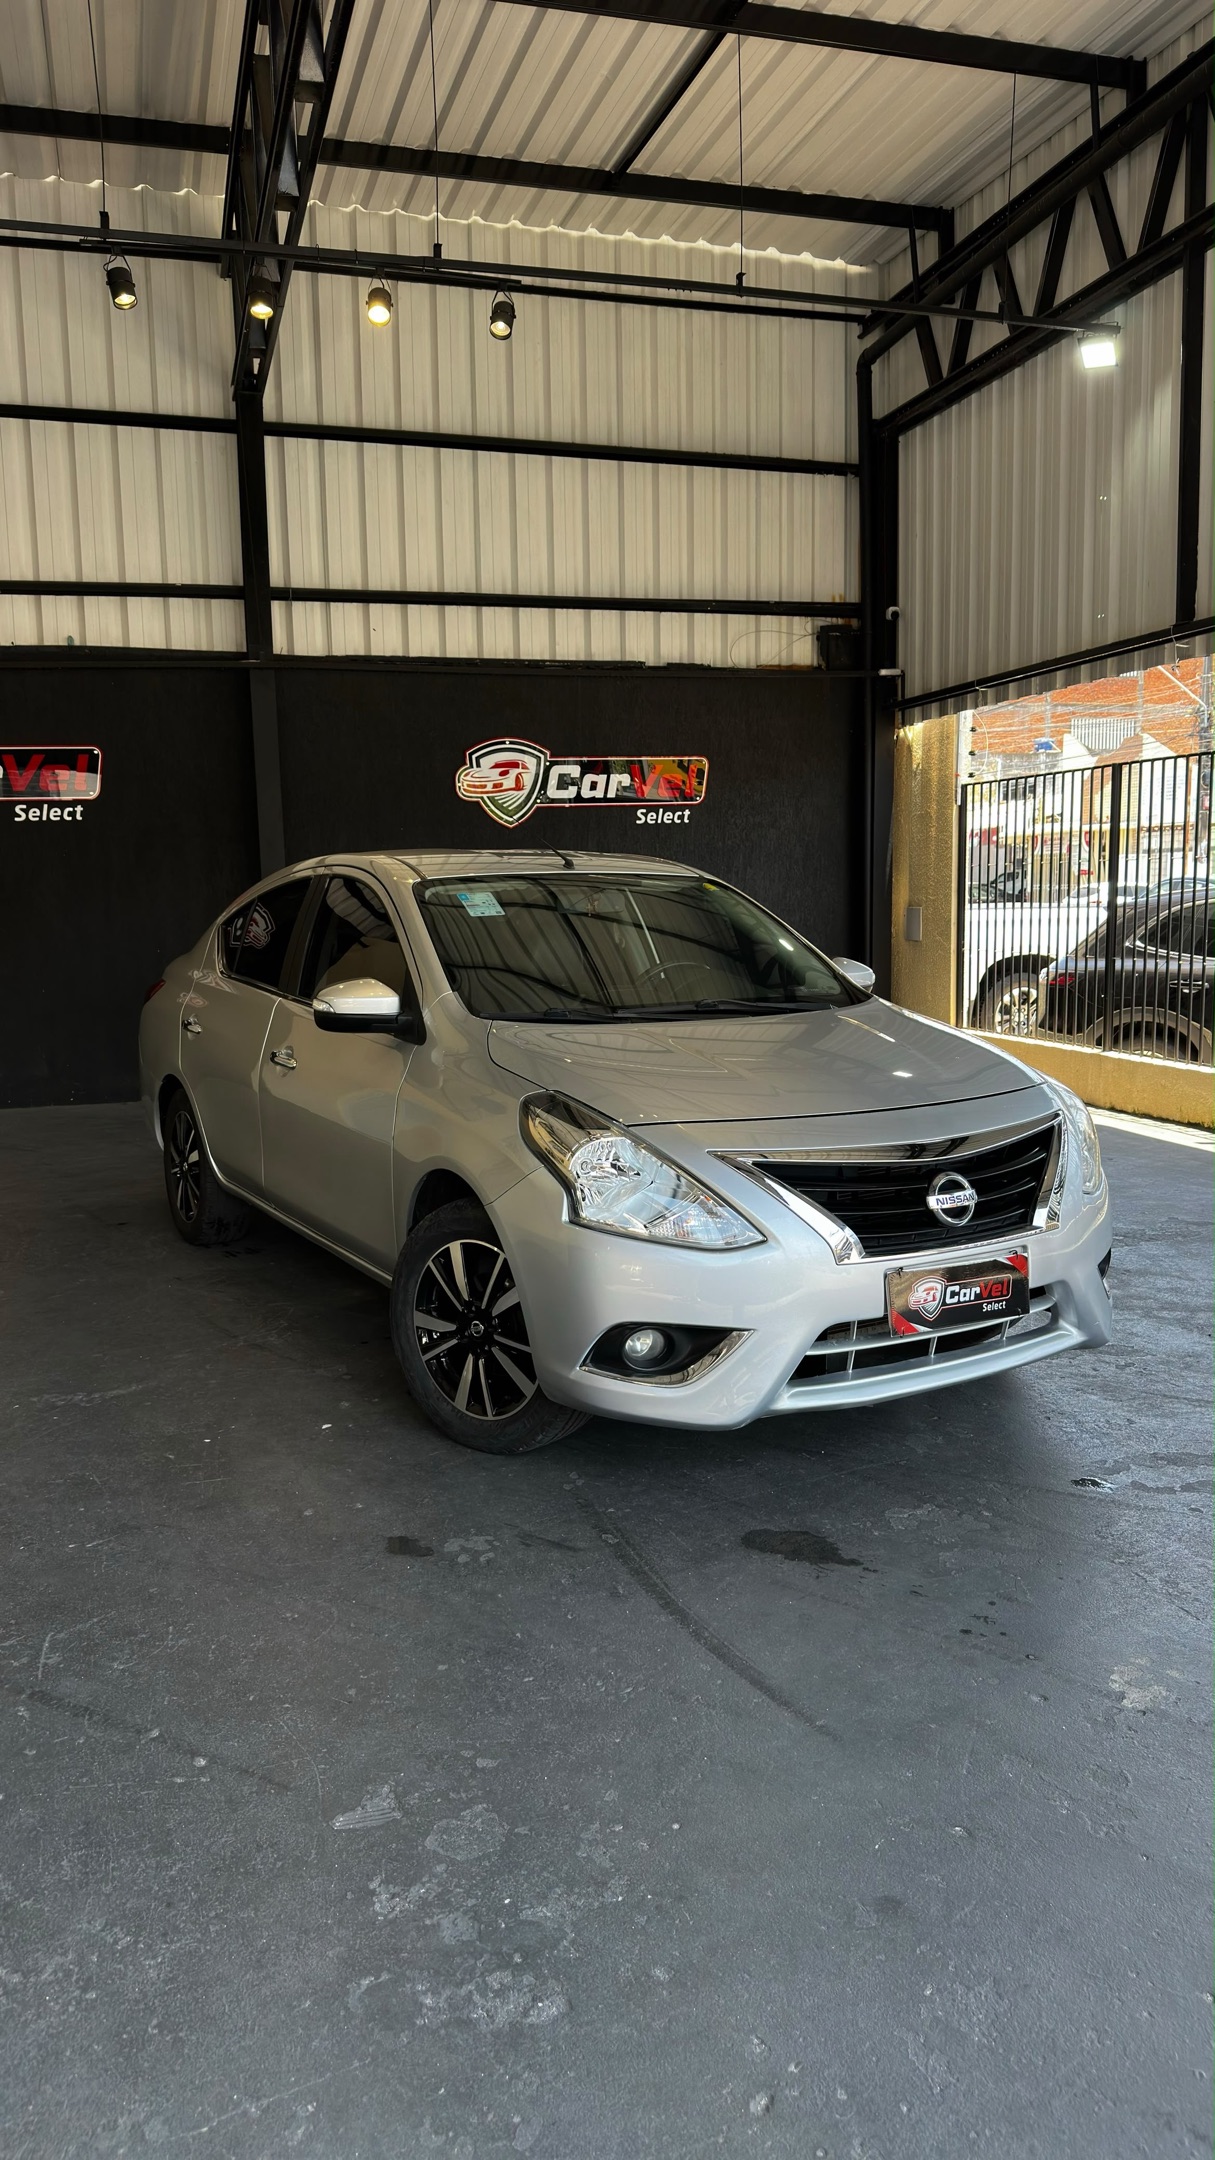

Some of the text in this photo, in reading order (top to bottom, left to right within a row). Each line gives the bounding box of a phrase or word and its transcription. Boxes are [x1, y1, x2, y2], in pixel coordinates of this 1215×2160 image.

[0, 754, 89, 792] Vel
[545, 764, 698, 799] CarVel
[14, 803, 84, 822] Select
[635, 808, 691, 825] Select
[935, 1192, 975, 1206] NISSAN
[945, 1277, 1009, 1304] CarVel
[982, 1300, 1007, 1312] Select
